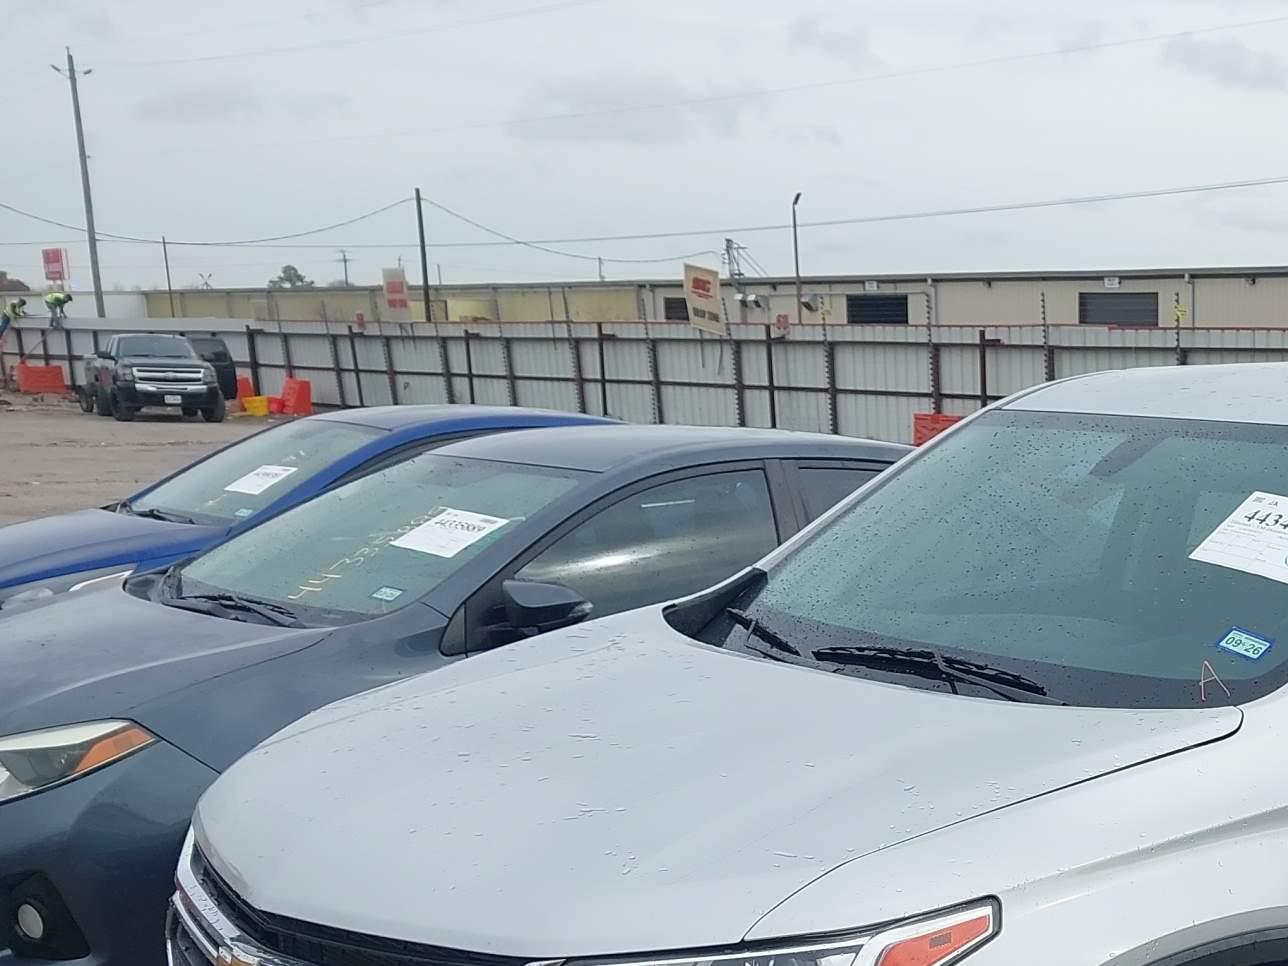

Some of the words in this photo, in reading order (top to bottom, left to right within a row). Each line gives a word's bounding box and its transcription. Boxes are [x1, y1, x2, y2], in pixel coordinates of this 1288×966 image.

[1225, 636, 1242, 648] 09
[1244, 643, 1263, 656] 26
[1199, 660, 1231, 701] A
